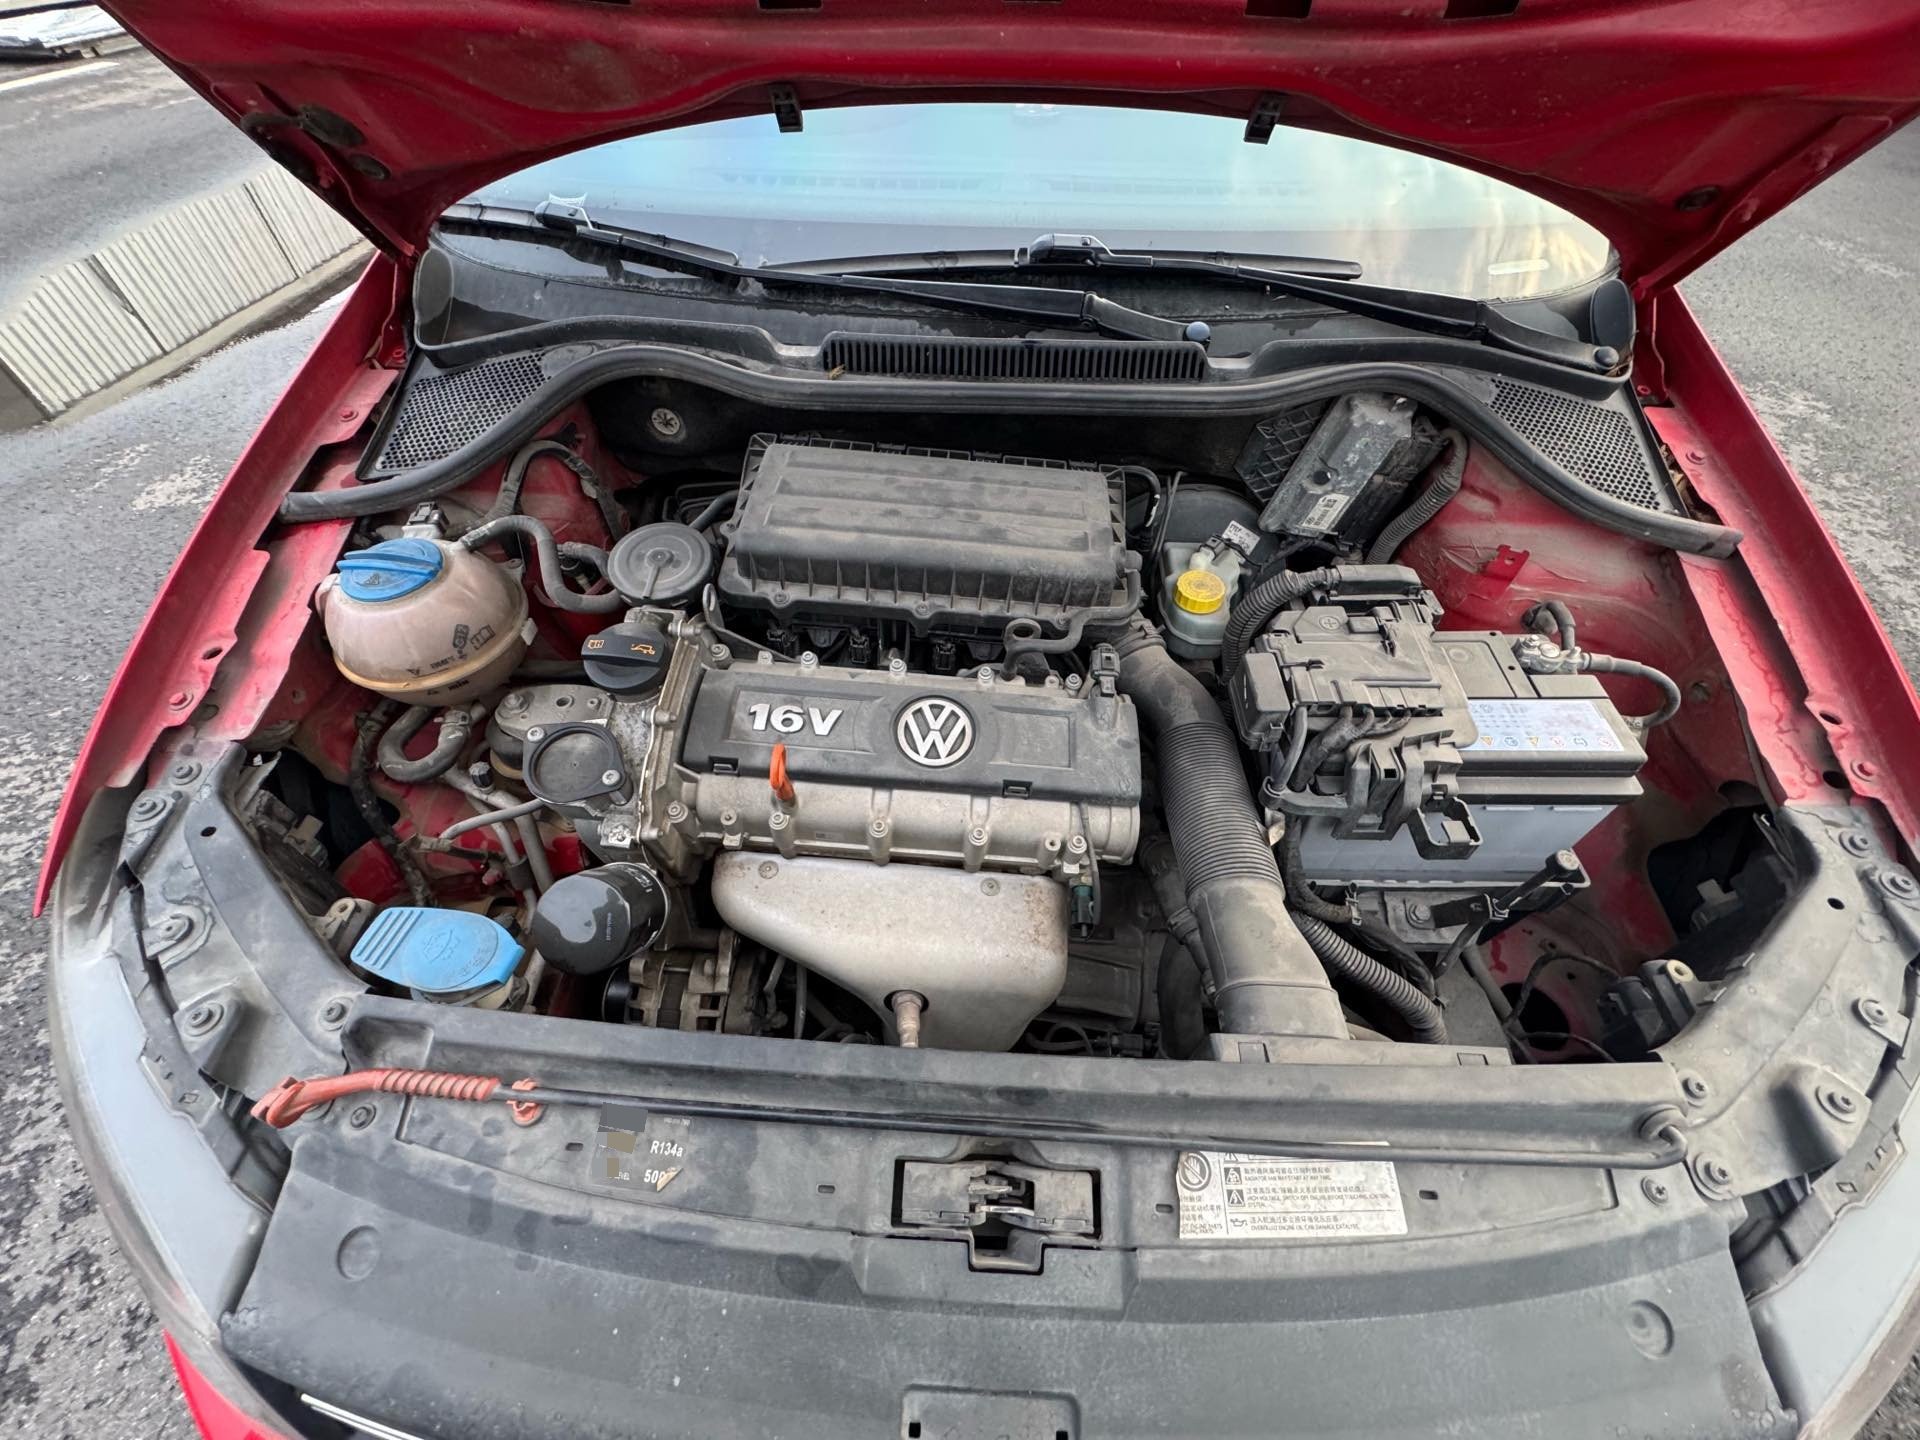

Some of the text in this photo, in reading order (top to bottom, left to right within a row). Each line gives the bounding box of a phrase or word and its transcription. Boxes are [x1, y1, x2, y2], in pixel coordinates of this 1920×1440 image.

[750, 703, 843, 736] 16V
[898, 700, 973, 766] VW
[650, 1140, 684, 1158] R134a
